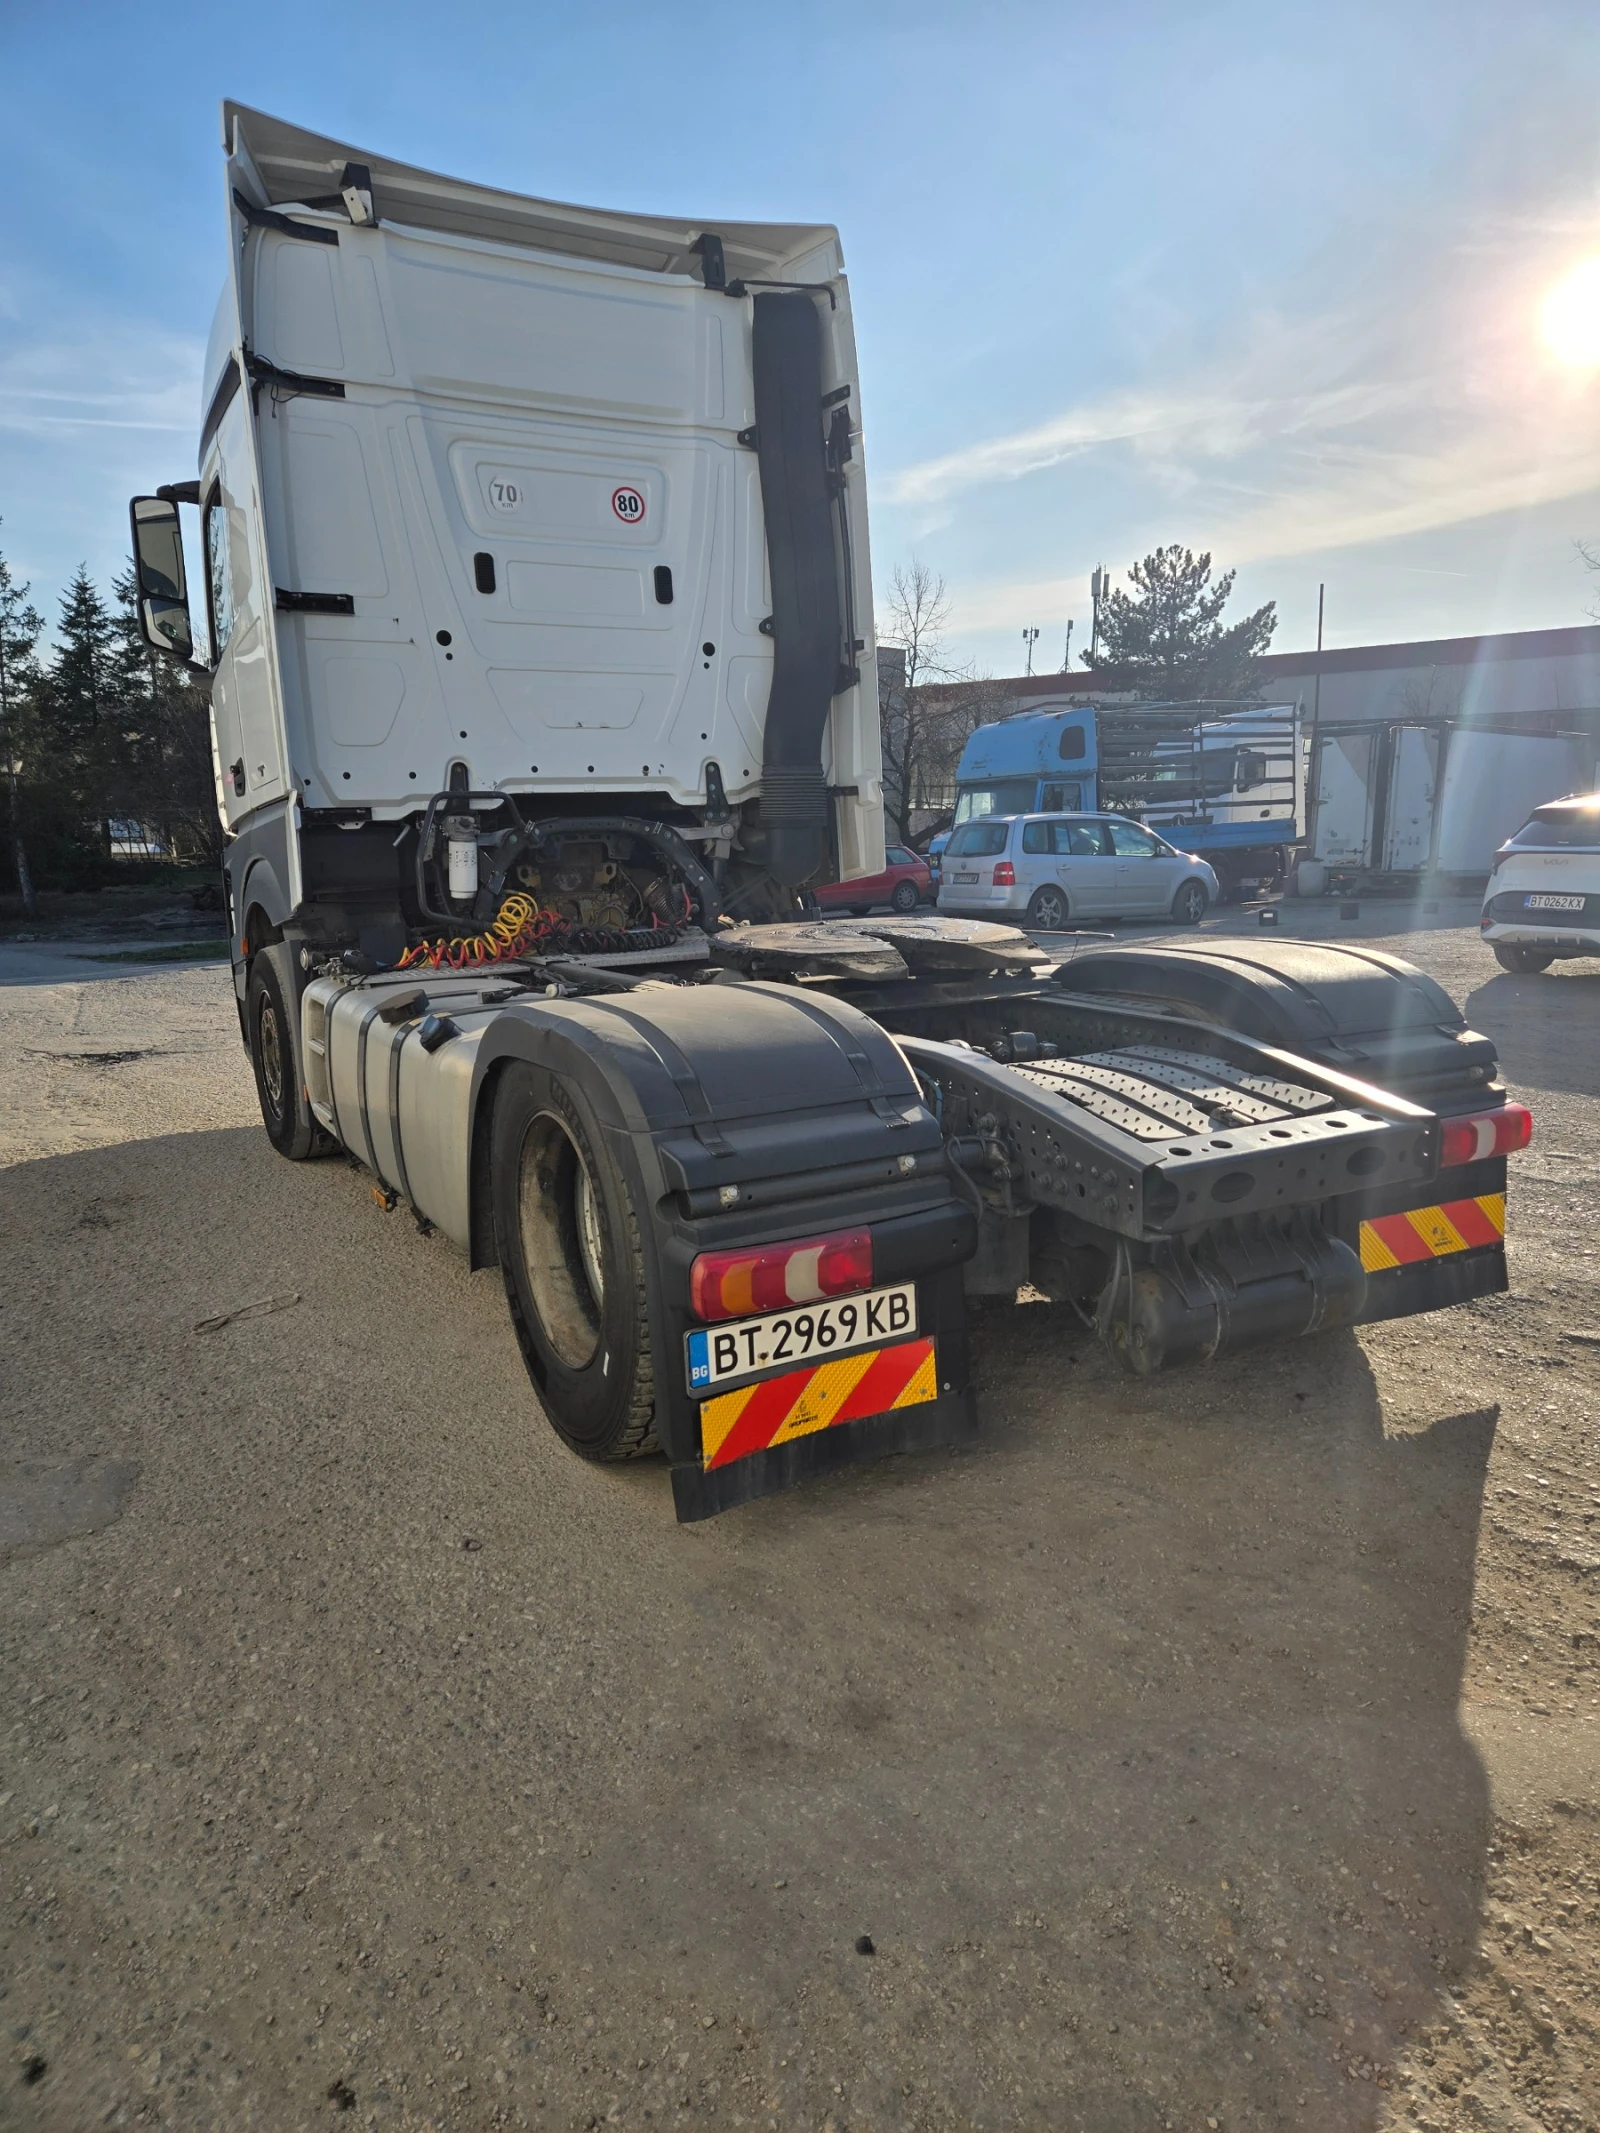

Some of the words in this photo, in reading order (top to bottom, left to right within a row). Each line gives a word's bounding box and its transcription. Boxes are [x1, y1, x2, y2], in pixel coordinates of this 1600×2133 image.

[493, 483, 518, 502] 70
[617, 494, 639, 513] 80
[1530, 896, 1545, 907] BT
[1544, 897, 1568, 908] 0262
[1568, 898, 1583, 909] KX
[714, 1325, 762, 1376] BT
[772, 1305, 858, 1360] 2969
[866, 1292, 910, 1337] KB
[692, 1366, 708, 1379] BG
